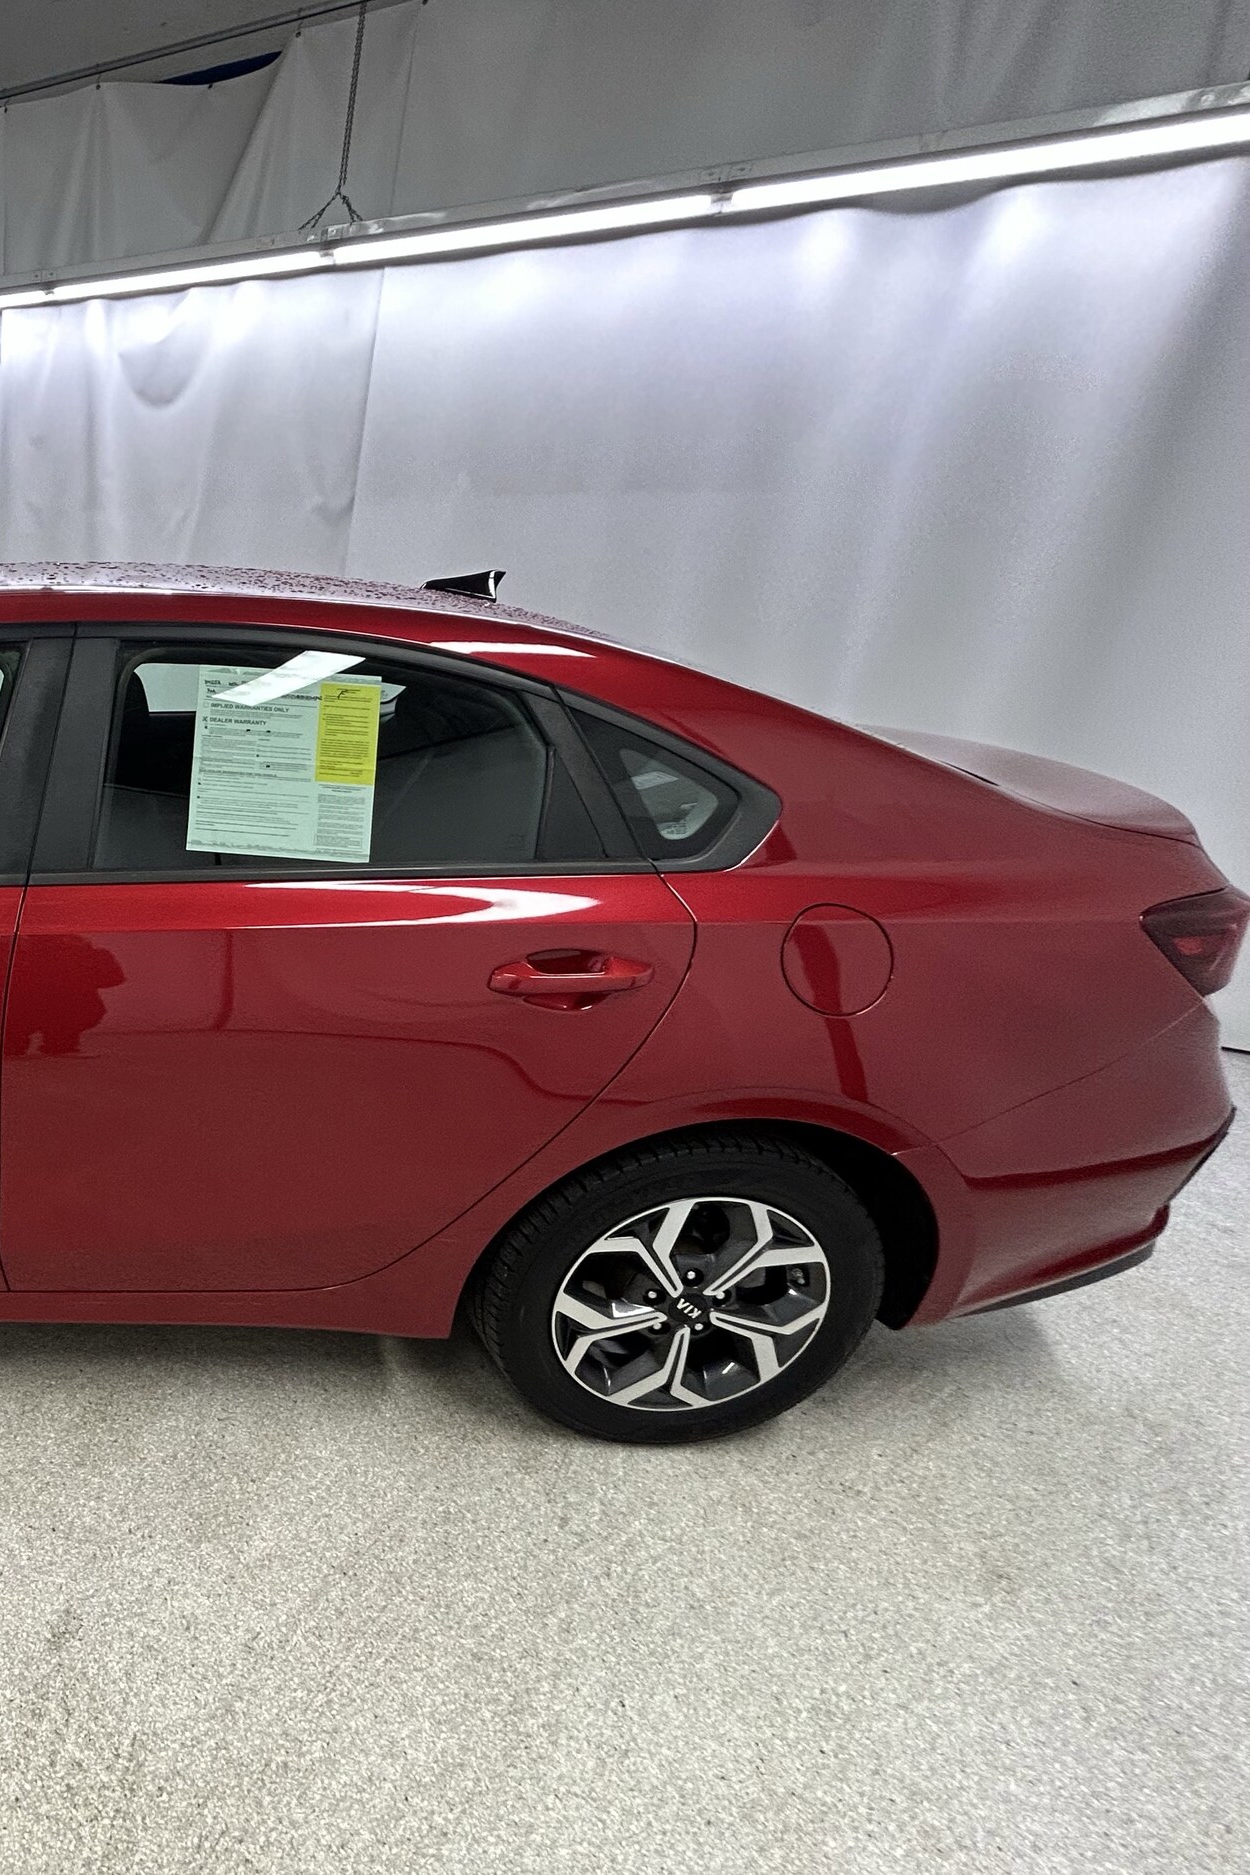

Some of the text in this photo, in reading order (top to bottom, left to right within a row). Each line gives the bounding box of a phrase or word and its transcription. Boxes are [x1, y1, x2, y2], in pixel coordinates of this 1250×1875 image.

[234, 704, 273, 712] WARRANTIES
[233, 718, 267, 726] WARRANTY
[676, 1298, 702, 1319] KIA
